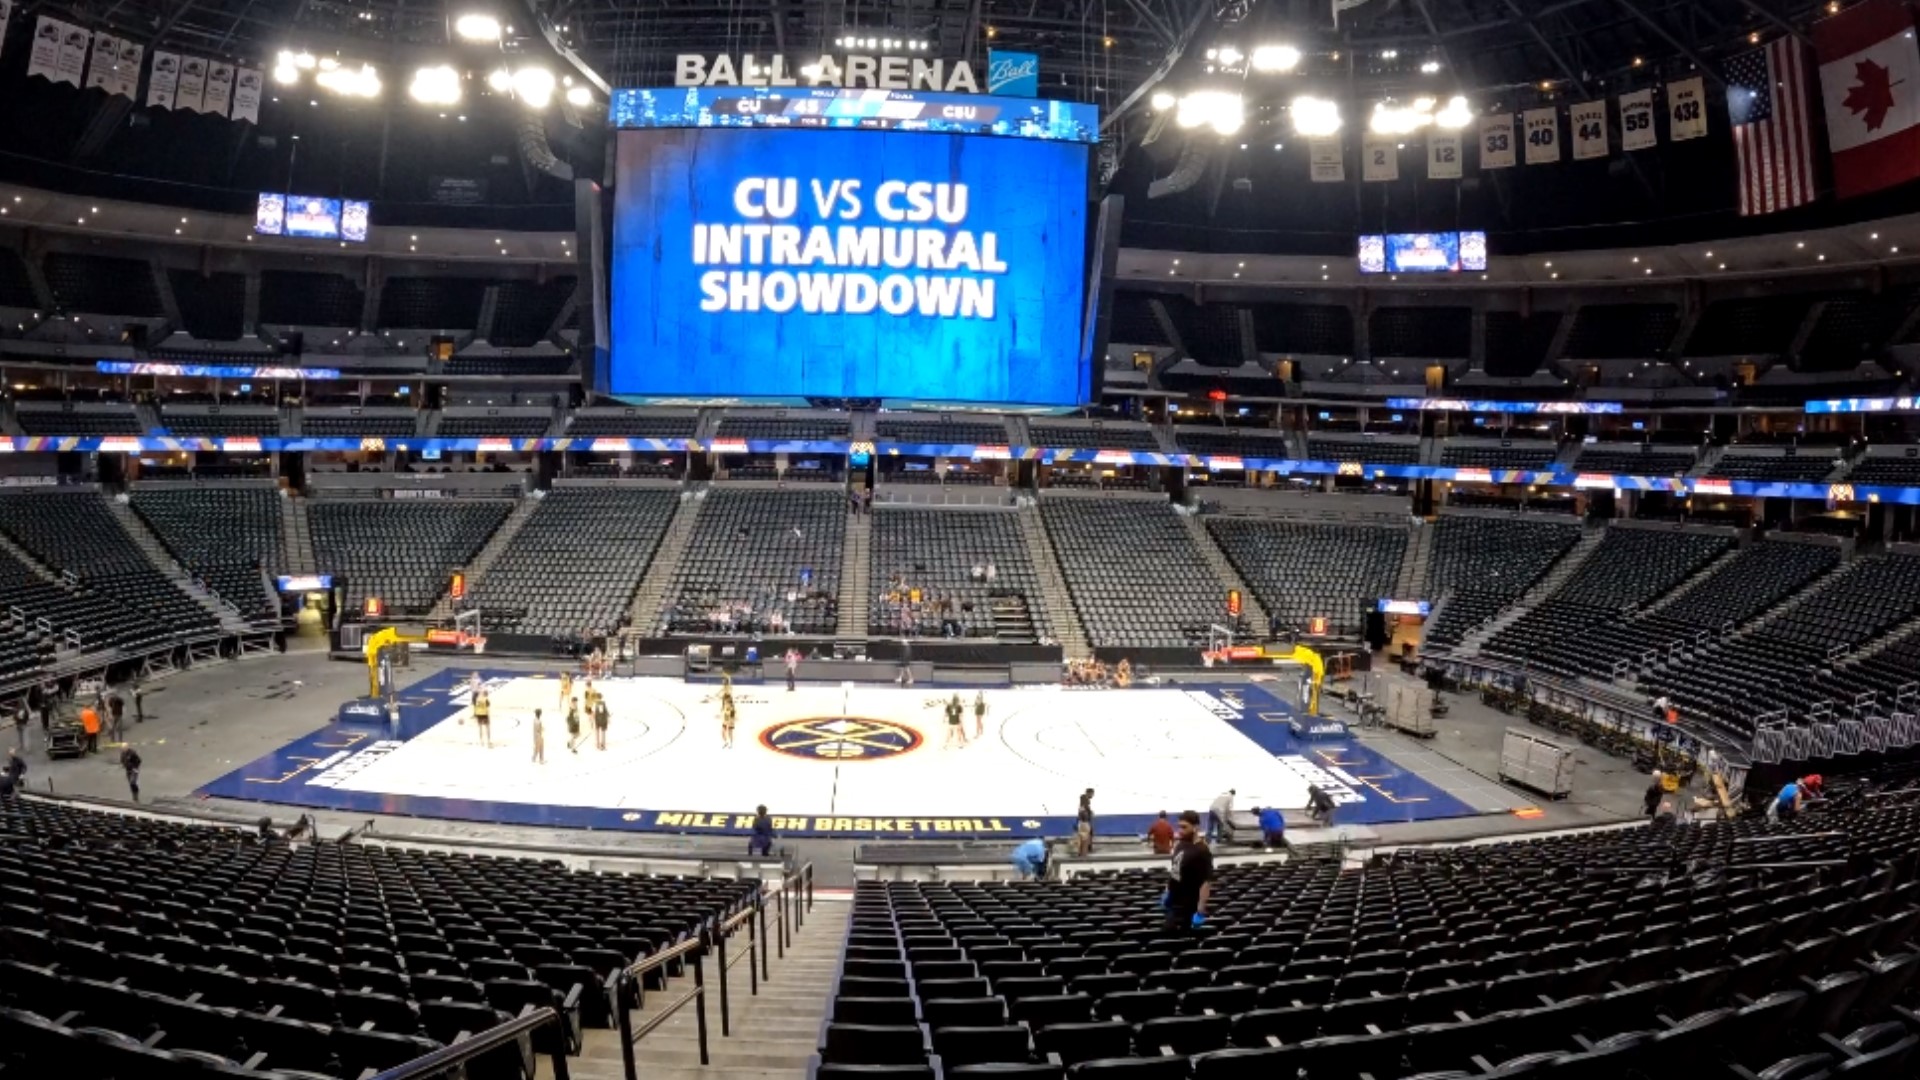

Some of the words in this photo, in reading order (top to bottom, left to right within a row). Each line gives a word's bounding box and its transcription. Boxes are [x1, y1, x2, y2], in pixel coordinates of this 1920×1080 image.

[675, 54, 797, 87] BALL
[808, 54, 980, 93] ARENA
[989, 59, 1036, 84] Ball
[737, 99, 761, 113] CU
[943, 106, 976, 120] CSU
[1673, 100, 1700, 122] 432
[1625, 112, 1649, 131] 55
[1529, 130, 1554, 146] 40
[1579, 122, 1601, 141] 44
[1486, 134, 1508, 153] 33
[1374, 151, 1385, 165] 2
[1434, 147, 1456, 163] 12
[734, 178, 797, 218] CU
[811, 179, 862, 219] VS
[875, 180, 968, 223] CSU
[693, 224, 1007, 272] INTRAMURAL
[700, 271, 996, 318] SHOWDOWN
[655, 812, 729, 827] MILE
[734, 815, 807, 830] HGH
[814, 817, 1011, 831] BASKETBALL
